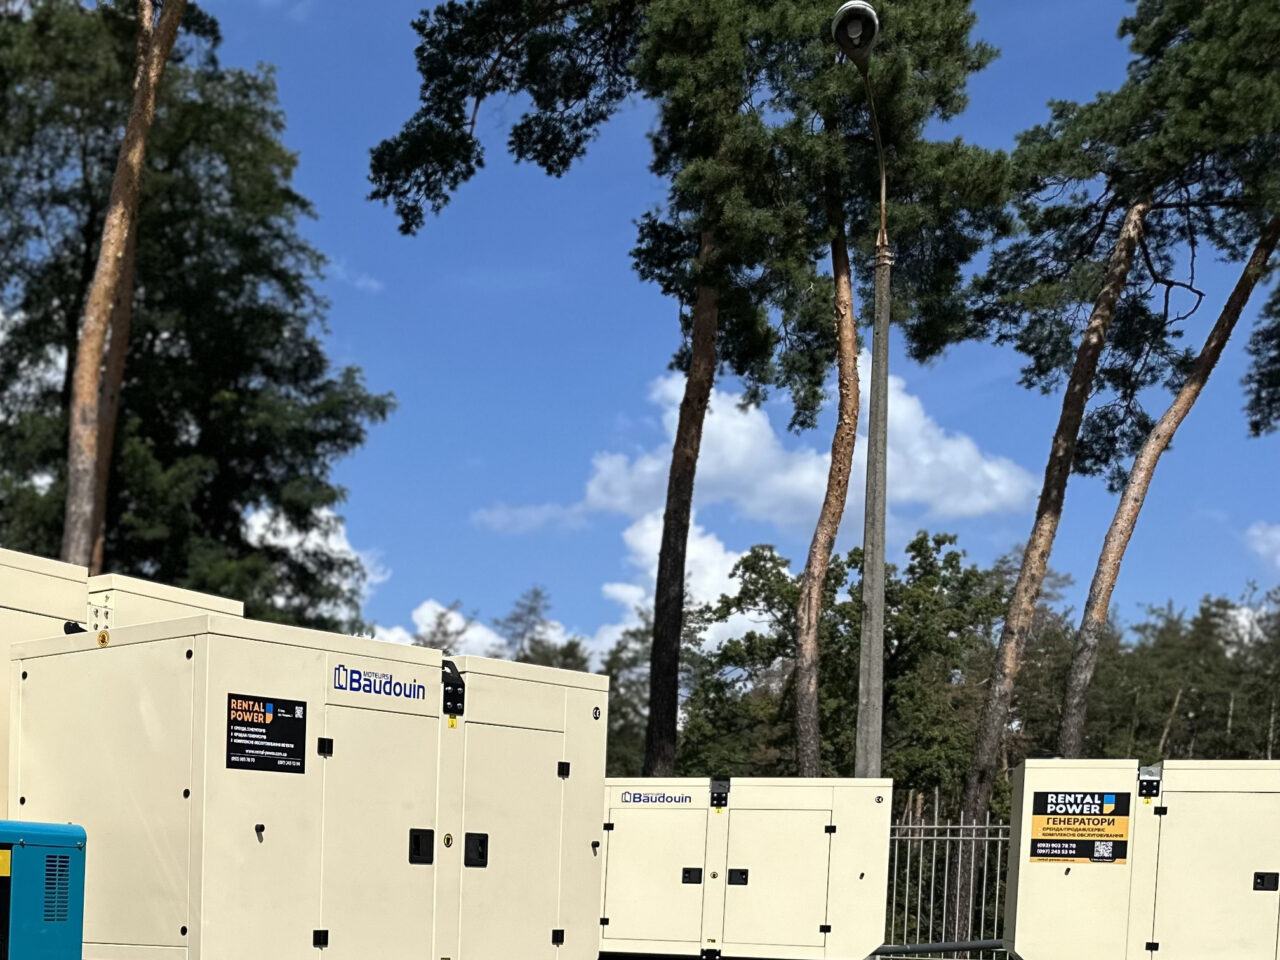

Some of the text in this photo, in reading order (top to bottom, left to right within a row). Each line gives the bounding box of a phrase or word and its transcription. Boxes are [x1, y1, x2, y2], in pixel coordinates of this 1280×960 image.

[363, 671, 389, 680] MOTEURS
[349, 669, 425, 700] Baudouin
[231, 699, 265, 712] RENTAL
[231, 711, 264, 723] POWER
[632, 793, 692, 803] Baudouin
[1047, 793, 1101, 804] RENTAL
[1047, 804, 1100, 814] POWER
[1046, 817, 1115, 826] ГЕНЕРАТОРИ
